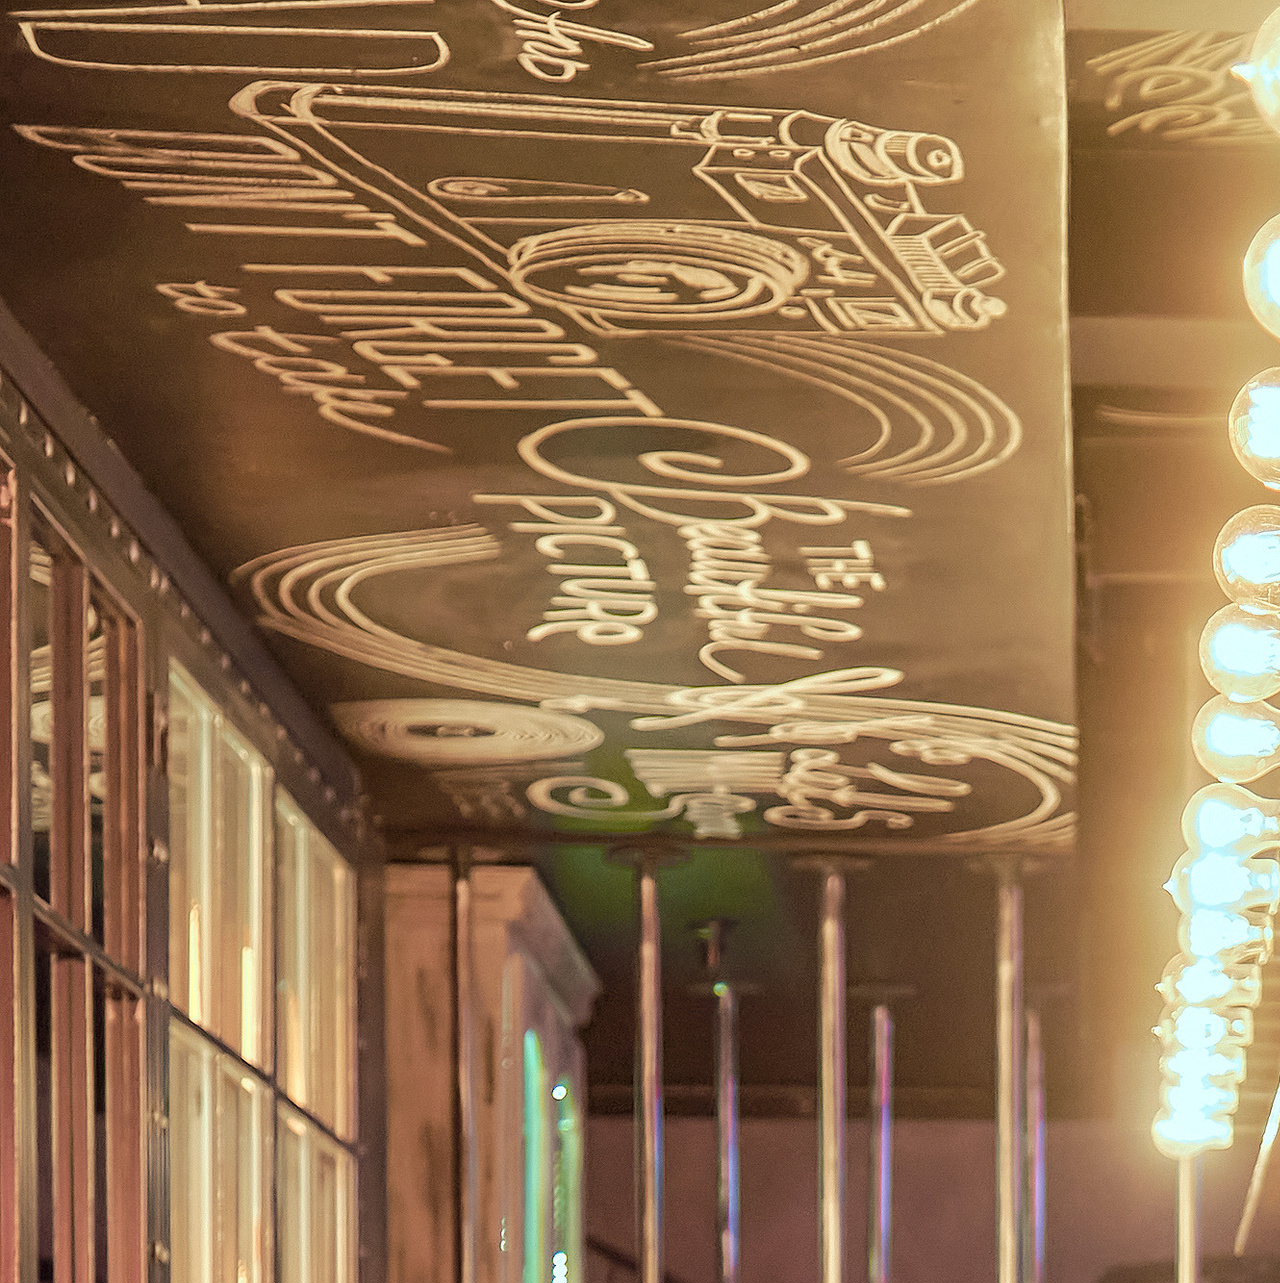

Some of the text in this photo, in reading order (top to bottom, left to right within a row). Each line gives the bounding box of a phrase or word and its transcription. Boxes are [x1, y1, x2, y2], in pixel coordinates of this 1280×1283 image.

[155, 279, 452, 452] to take
[241, 263, 664, 417] FORGET
[798, 538, 887, 592] THE
